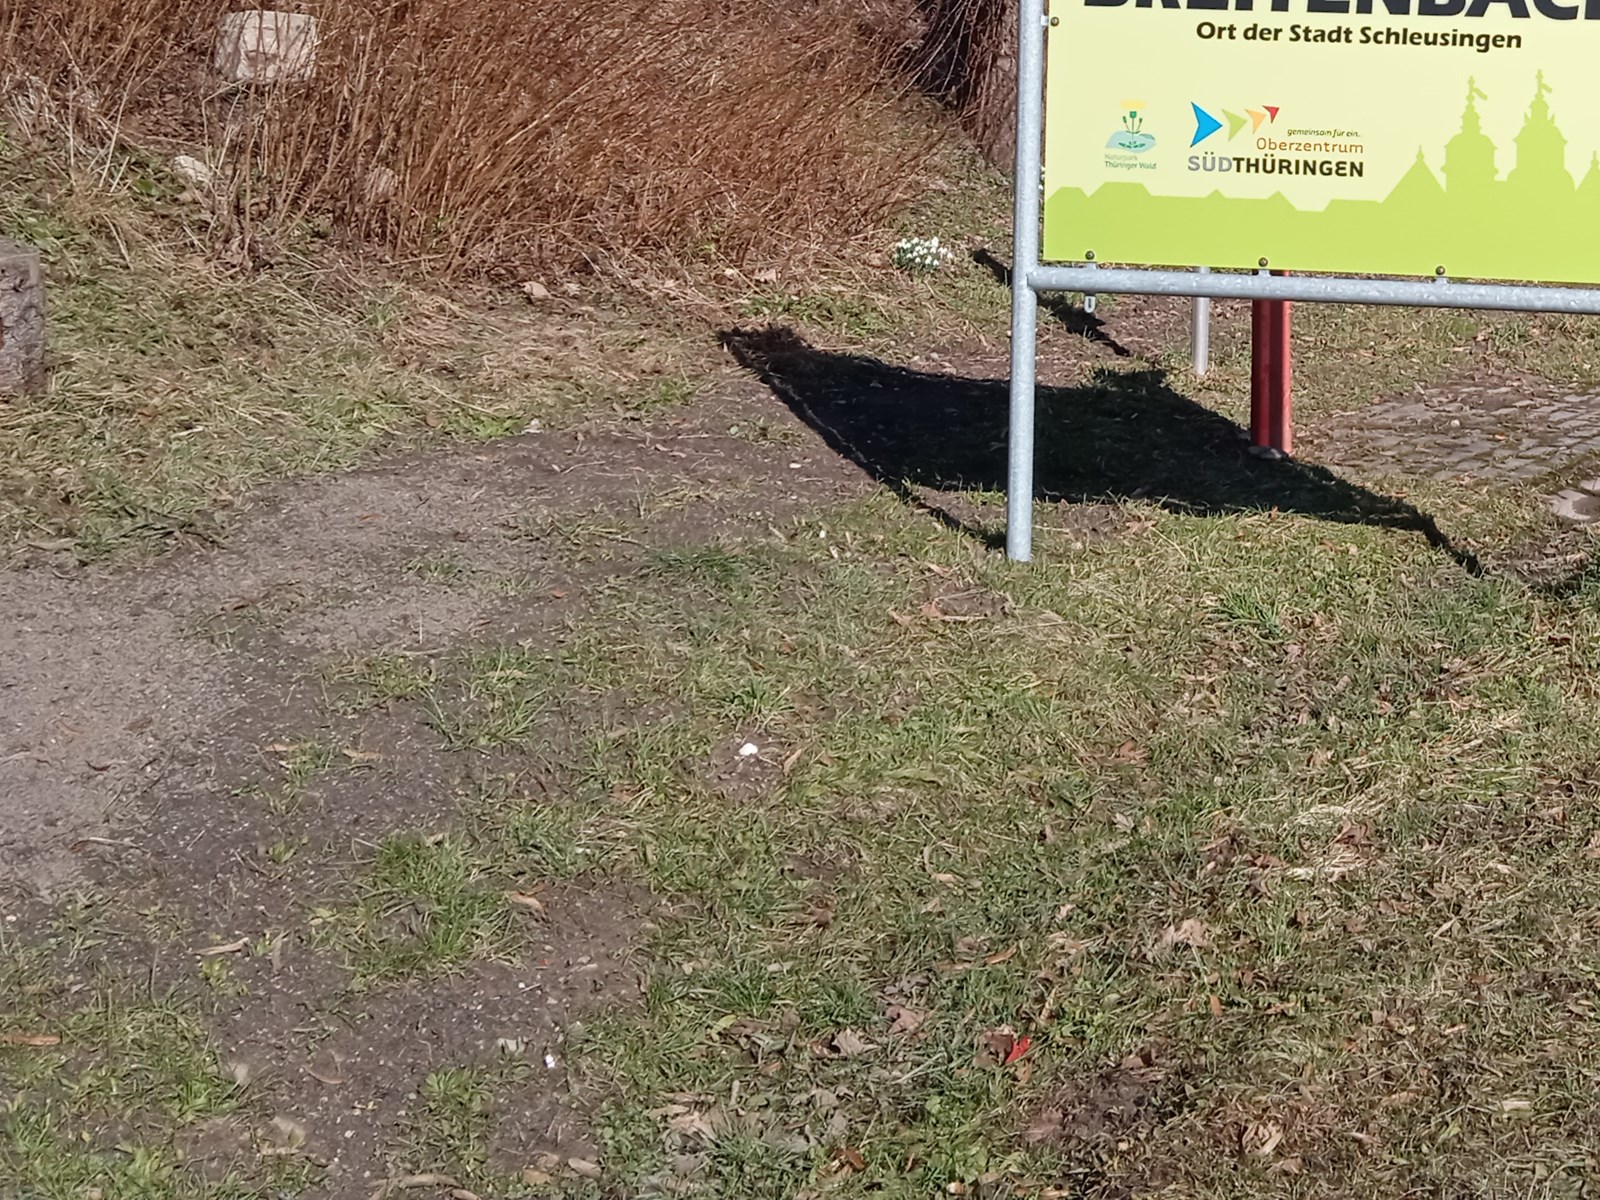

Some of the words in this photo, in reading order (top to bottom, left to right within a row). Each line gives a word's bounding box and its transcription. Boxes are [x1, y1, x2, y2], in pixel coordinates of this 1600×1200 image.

[1195, 21, 1237, 40] Ort
[1242, 23, 1283, 42] der
[1288, 24, 1353, 44] Stadt
[1358, 26, 1523, 54] Schleusingen
[1287, 128, 1332, 137] gemeinsam
[1256, 137, 1364, 154] Oberzentrum
[1187, 152, 1364, 178] SÜDTHÜRINGEN
